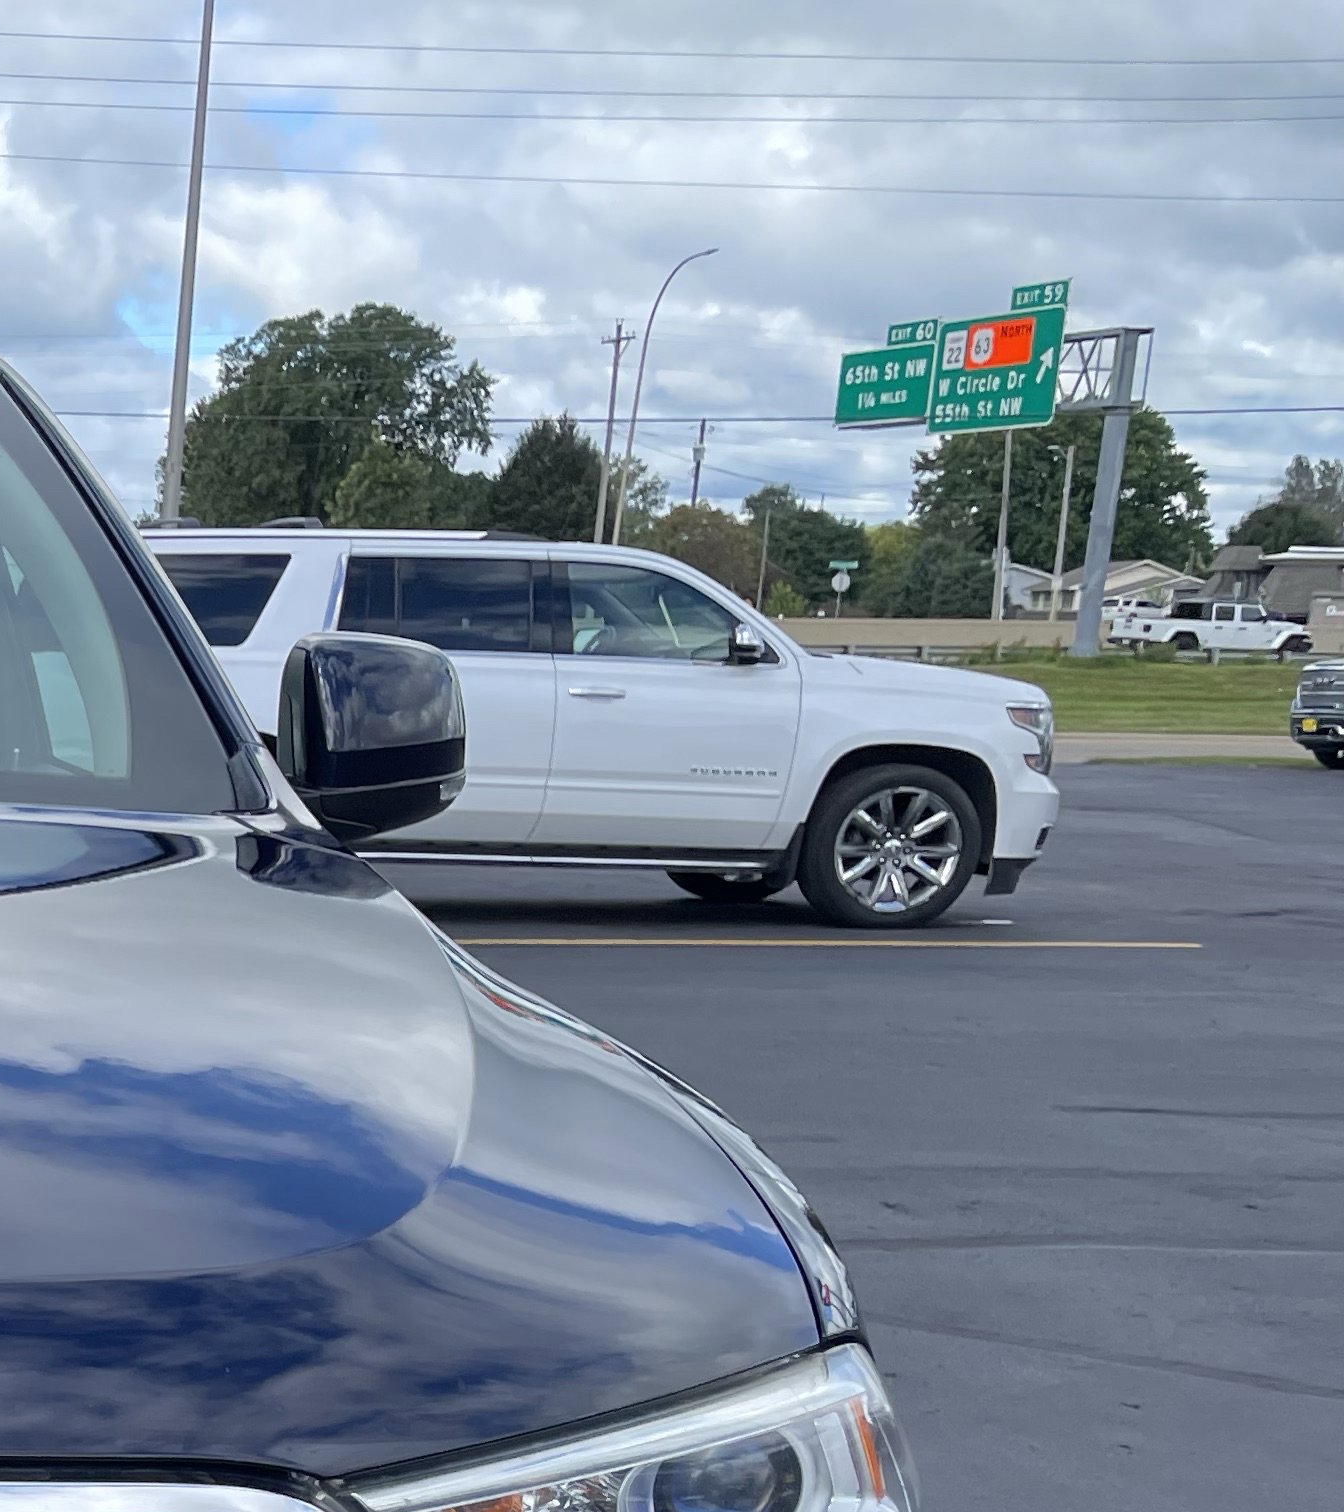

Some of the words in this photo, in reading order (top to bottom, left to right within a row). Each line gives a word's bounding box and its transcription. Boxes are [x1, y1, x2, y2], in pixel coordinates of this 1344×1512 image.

[1043, 283, 1065, 304] 59
[915, 321, 934, 341] 60
[1000, 324, 1033, 338] NORTH
[946, 346, 962, 364] 22
[974, 337, 990, 355] 63
[845, 365, 879, 386] 65th
[884, 361, 900, 381] St
[904, 358, 927, 378] NW
[938, 378, 951, 397] W
[956, 374, 1001, 395] Circle
[1007, 370, 1026, 390] Dr
[934, 403, 970, 423] 55th
[976, 399, 993, 418] St
[999, 396, 1023, 416] NW
